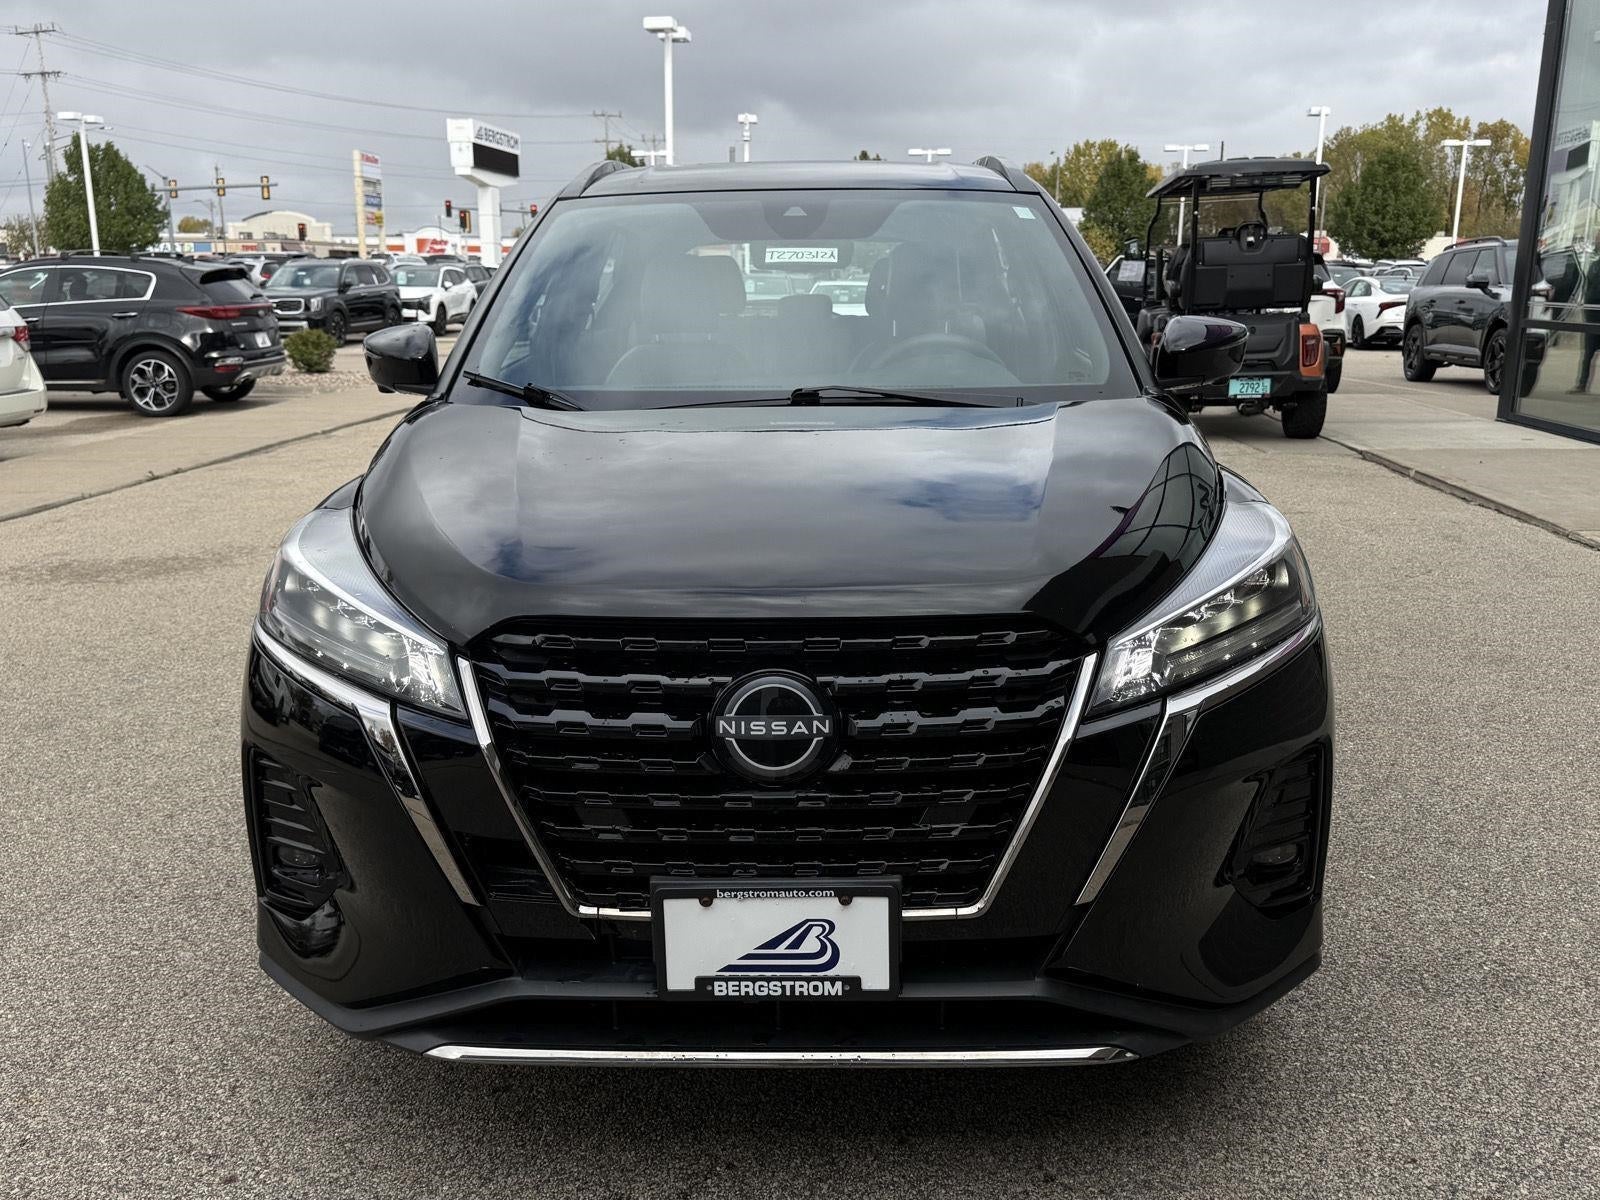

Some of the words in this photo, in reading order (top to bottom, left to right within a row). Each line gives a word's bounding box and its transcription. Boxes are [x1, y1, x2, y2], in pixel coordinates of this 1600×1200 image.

[1239, 382, 1260, 394] 2792
[719, 719, 830, 735] NISSAN
[716, 889, 835, 899] bergstromauto.com
[713, 980, 843, 996] BERGSTROM
